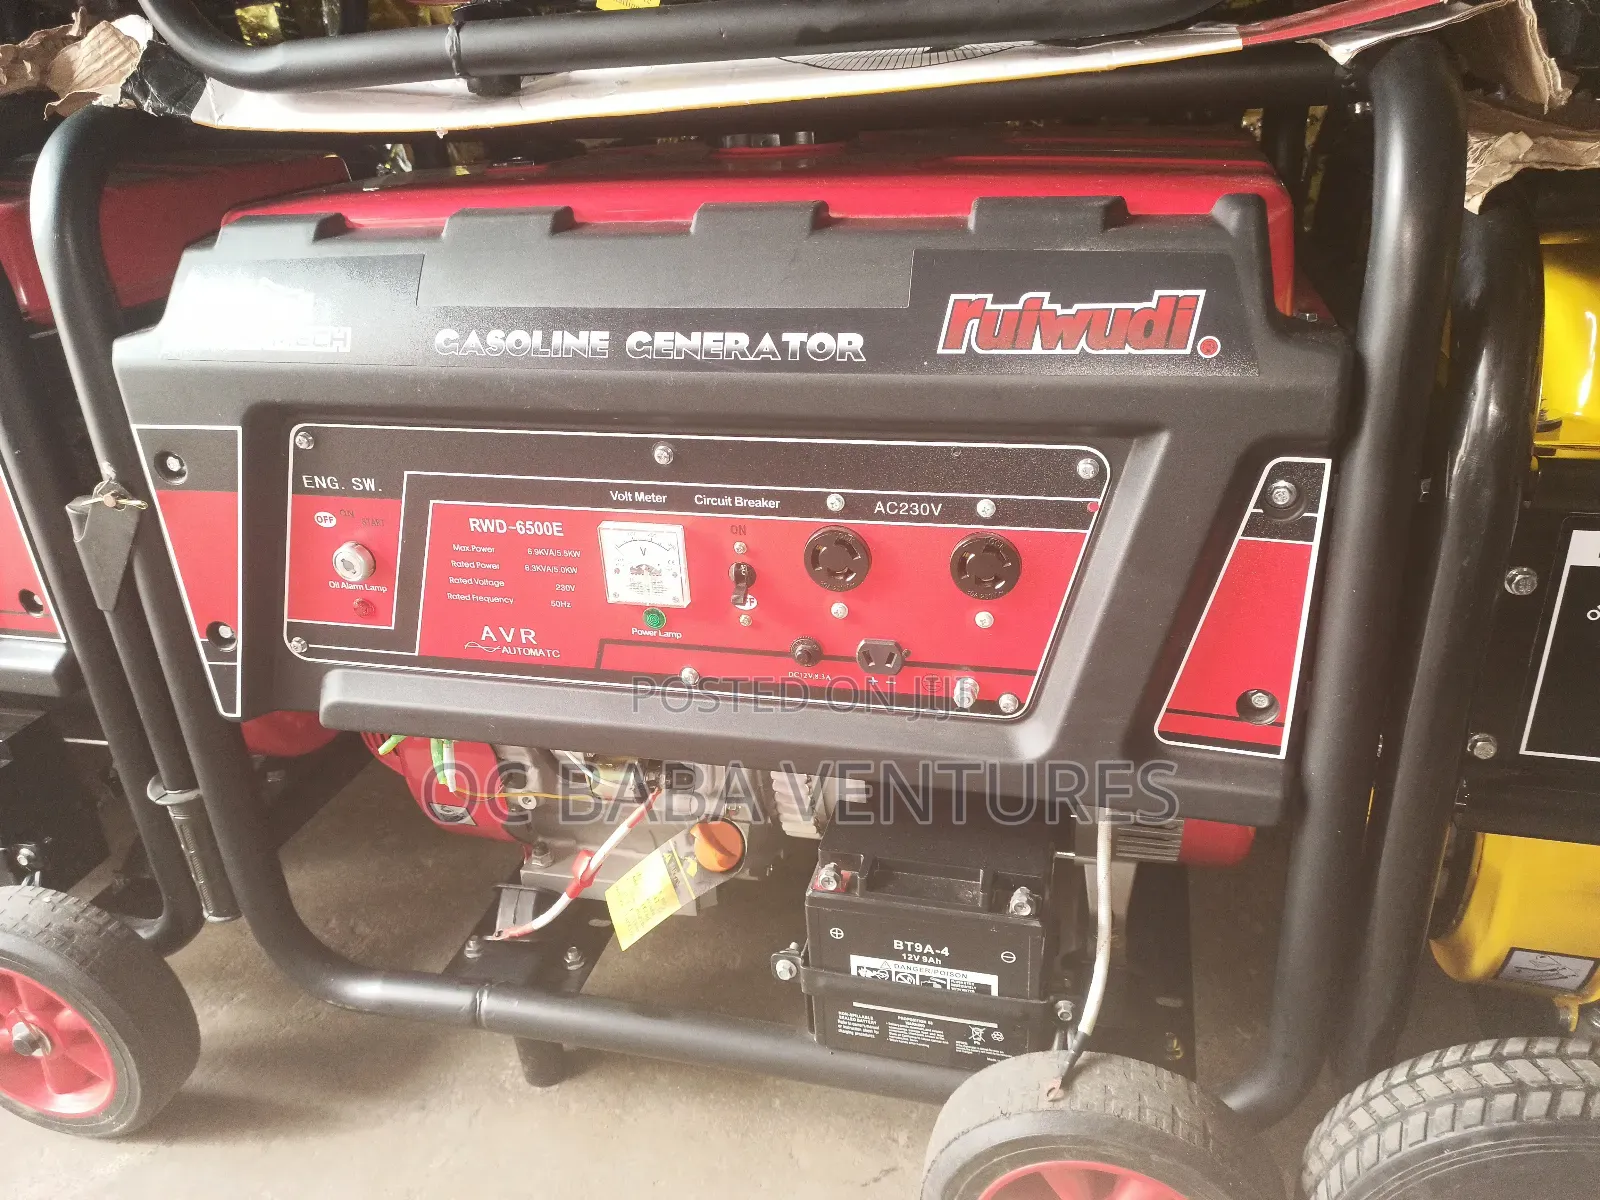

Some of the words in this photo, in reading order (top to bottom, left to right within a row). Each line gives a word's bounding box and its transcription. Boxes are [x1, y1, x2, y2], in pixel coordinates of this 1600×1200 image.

[937, 289, 1206, 355] ruiwudi
[434, 329, 609, 359] GASOLINE
[626, 331, 866, 363] GENERATOR
[302, 475, 345, 490] ENG.
[351, 477, 382, 492] SW.
[610, 490, 632, 502] Volt
[635, 491, 667, 503] Meter
[694, 495, 732, 507] Circuit
[735, 497, 780, 509] Breaker
[874, 501, 943, 516] AC230V
[316, 515, 334, 524] OFF
[469, 518, 564, 536] RWD-6500E
[731, 525, 747, 535] ON
[640, 547, 647, 556] V
[451, 560, 475, 569] Rated
[476, 562, 500, 570] Power
[328, 581, 341, 589] Oil
[342, 583, 364, 591] Alarm
[365, 584, 388, 593] Lamp
[449, 577, 473, 585] Rated
[474, 578, 505, 588] Voltage
[555, 584, 576, 592] 230V
[447, 593, 471, 601] Rated
[472, 595, 514, 604] Frequency
[481, 625, 537, 644] AVR
[631, 627, 657, 637] Power
[658, 629, 682, 639] Lamp
[501, 646, 560, 658] AUTOMATC
[893, 940, 949, 957] BT9A-4
[902, 953, 920, 961] 12V
[922, 956, 941, 965] 9Ah
[894, 963, 968, 979] DANGER/POISON
